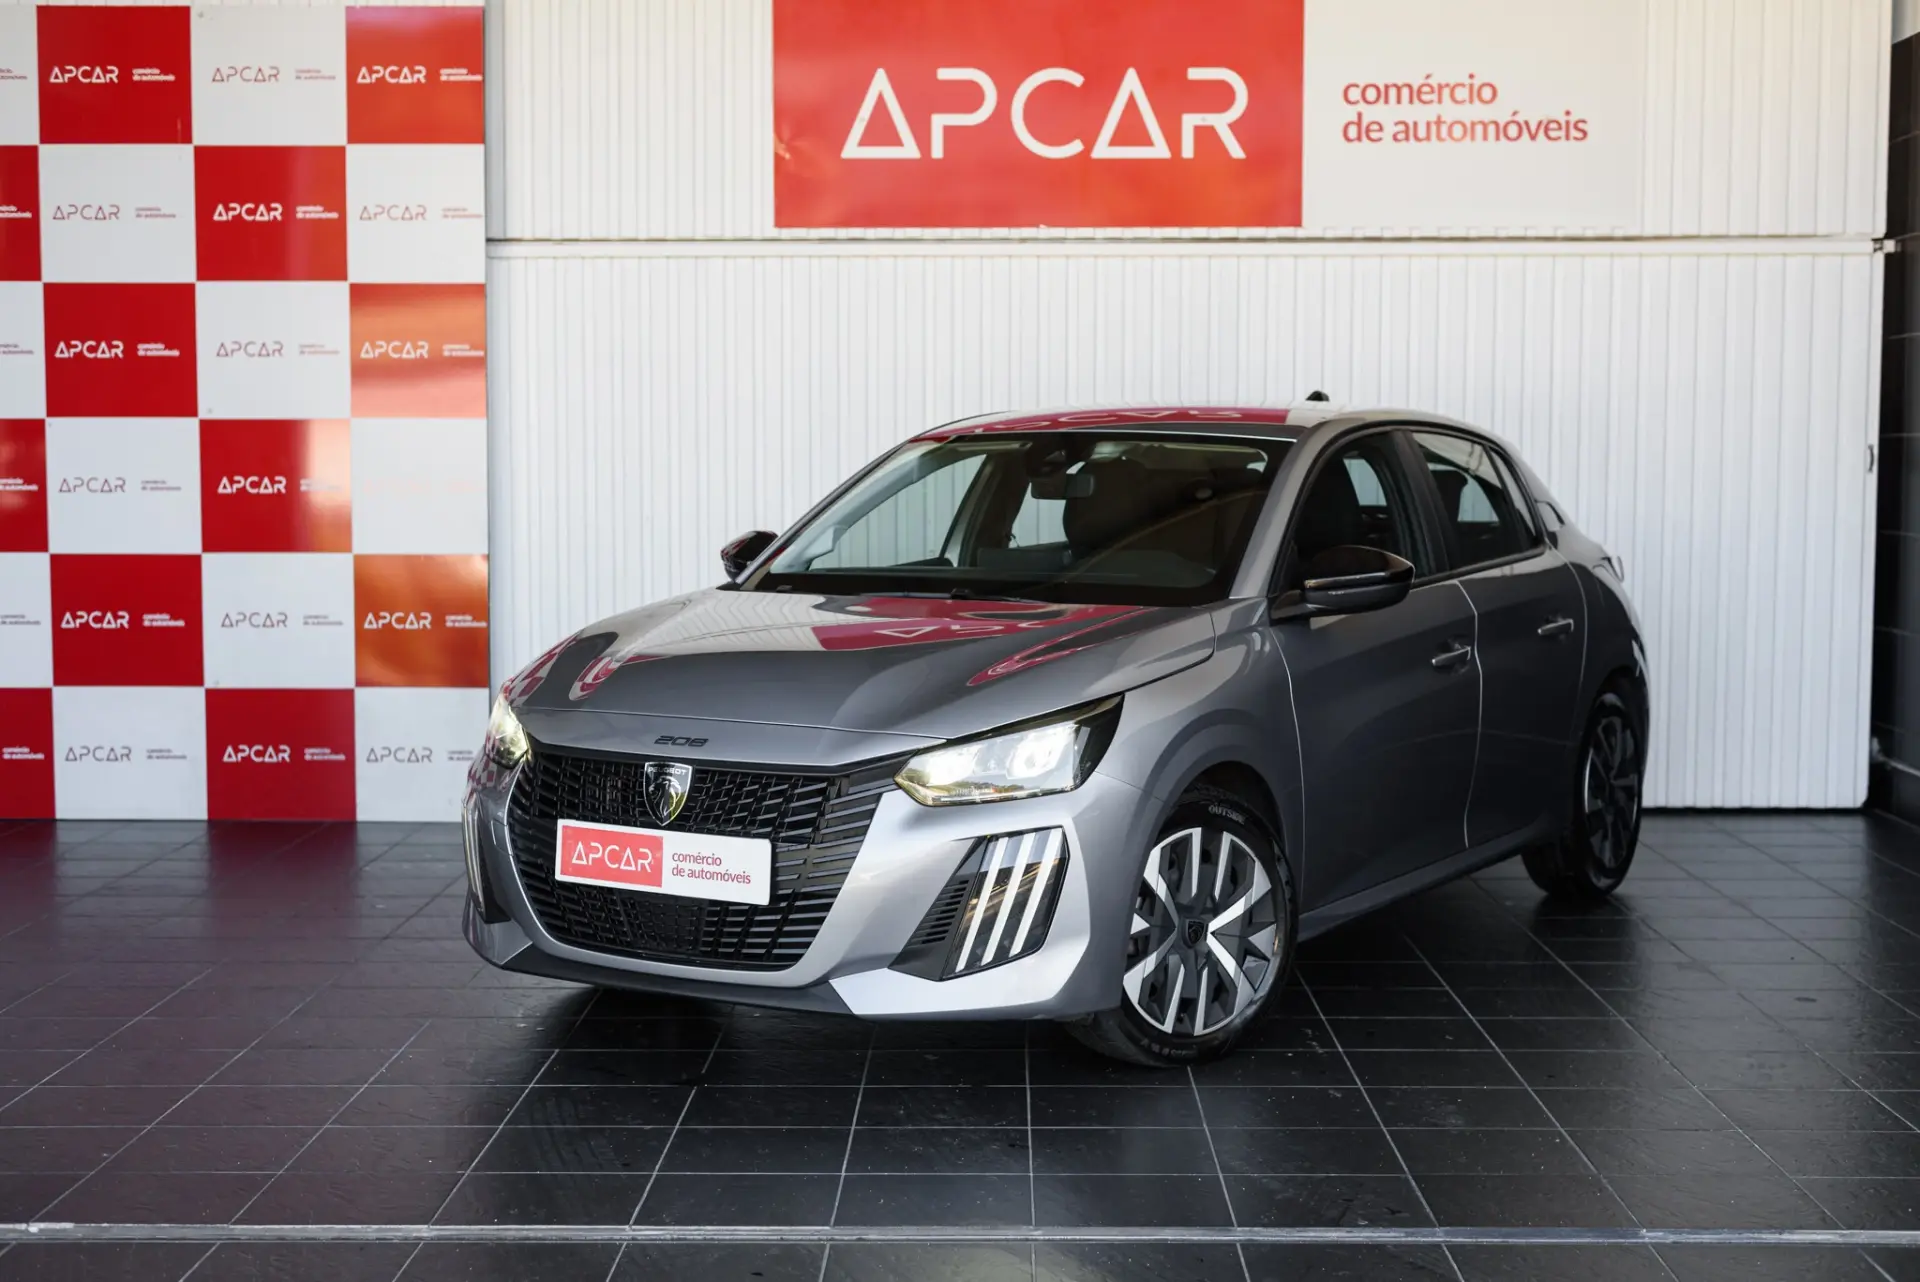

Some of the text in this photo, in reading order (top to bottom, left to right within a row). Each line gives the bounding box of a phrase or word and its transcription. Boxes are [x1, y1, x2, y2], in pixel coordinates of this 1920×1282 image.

[50, 66, 118, 83] APCAR
[212, 66, 280, 83] APCAR
[357, 66, 426, 83] APCAR
[1342, 73, 1498, 105] comércio
[840, 66, 1249, 160] APCAR
[1342, 110, 1589, 143] de automóveis
[52, 204, 120, 220] APCAR
[213, 203, 282, 221] APCAR
[359, 205, 427, 221] APCAR
[55, 340, 124, 358] APCAR
[216, 341, 283, 357] APCAR
[360, 341, 428, 359] APCAR
[58, 477, 126, 493] APCAR
[218, 476, 286, 494] APCAR
[61, 611, 129, 628] APCAR
[221, 612, 288, 628] APCAR
[364, 612, 431, 629] APCAR
[654, 735, 709, 747] 208
[65, 746, 131, 762] APCAR
[223, 745, 290, 762] APCAR
[366, 747, 432, 763] APCAR
[571, 841, 653, 872] APCAR
[672, 851, 722, 867] comércio
[671, 864, 751, 885] de automóveis
